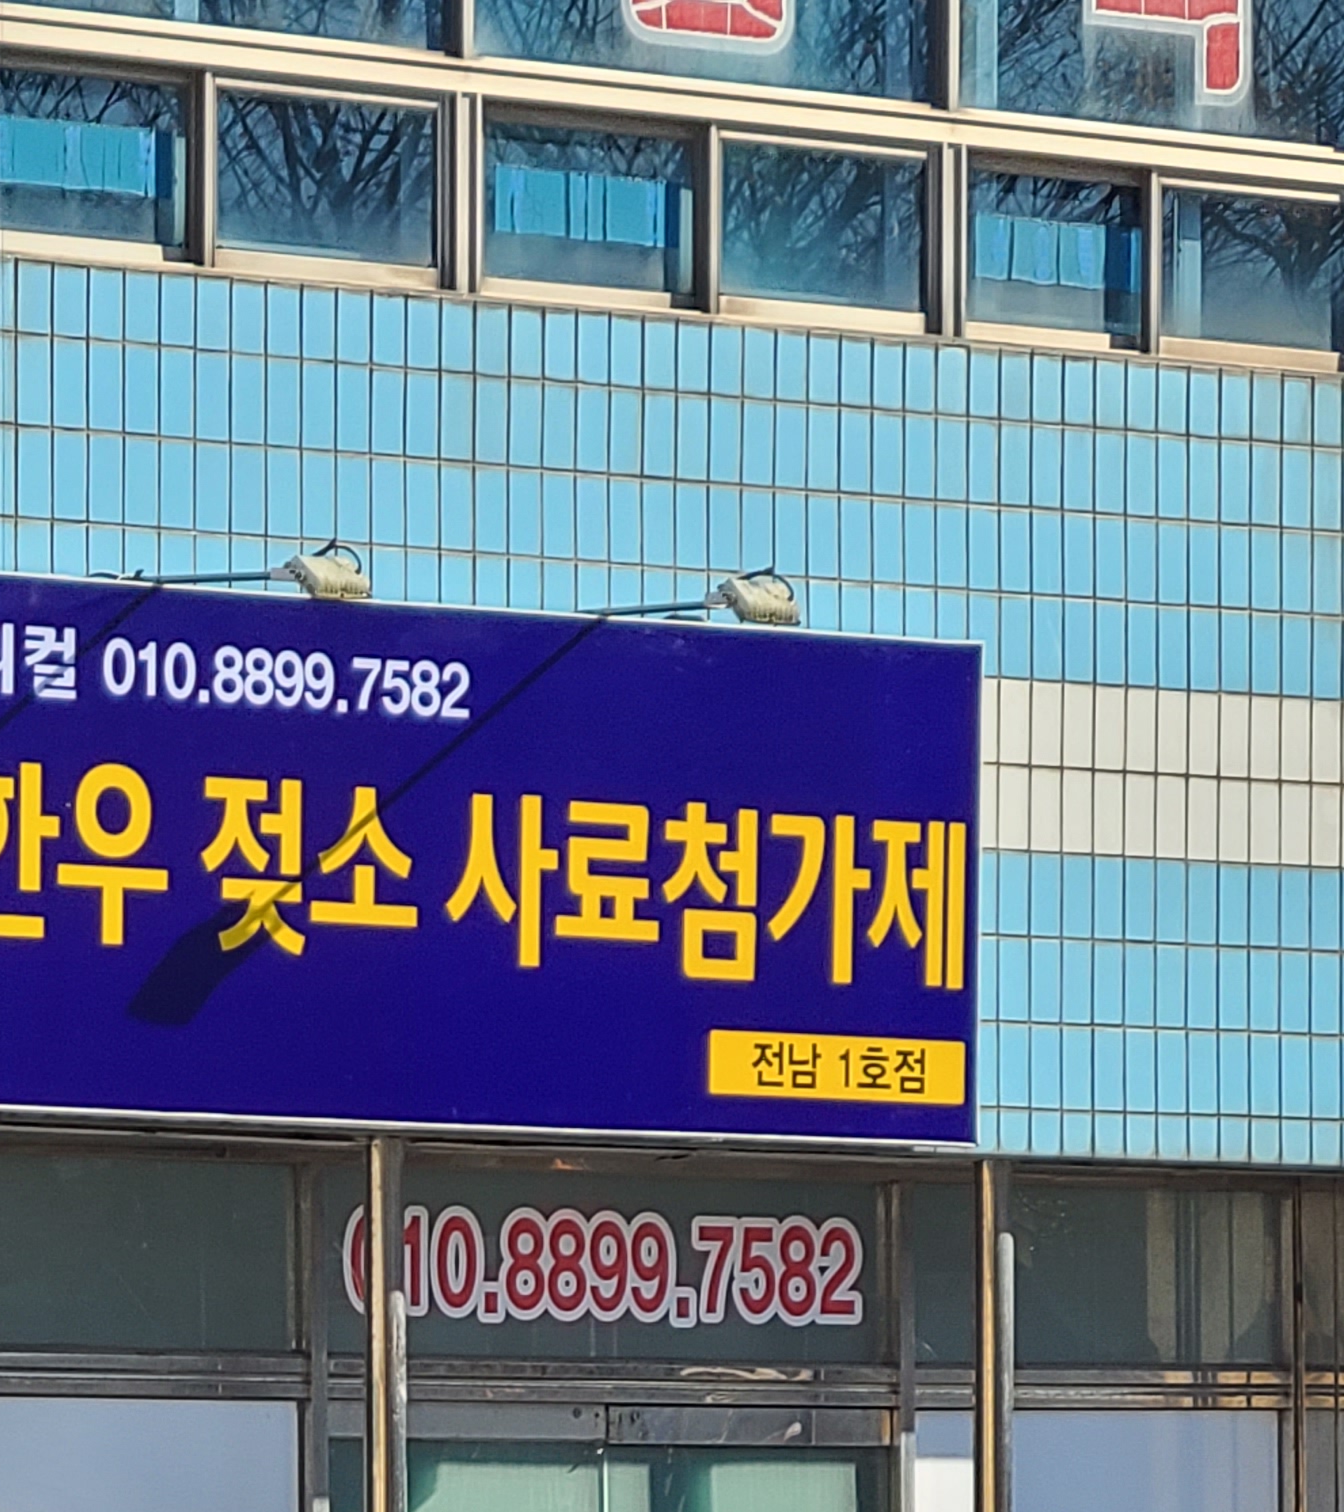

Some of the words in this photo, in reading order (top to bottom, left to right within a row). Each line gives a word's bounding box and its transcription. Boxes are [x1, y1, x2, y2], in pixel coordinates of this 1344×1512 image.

[102, 636, 471, 720] 010.8899.7582
[200, 775, 419, 956] 젖소
[447, 791, 965, 990] 사료첨가제
[750, 1041, 822, 1091] 전남
[838, 1046, 928, 1095] 1호점
